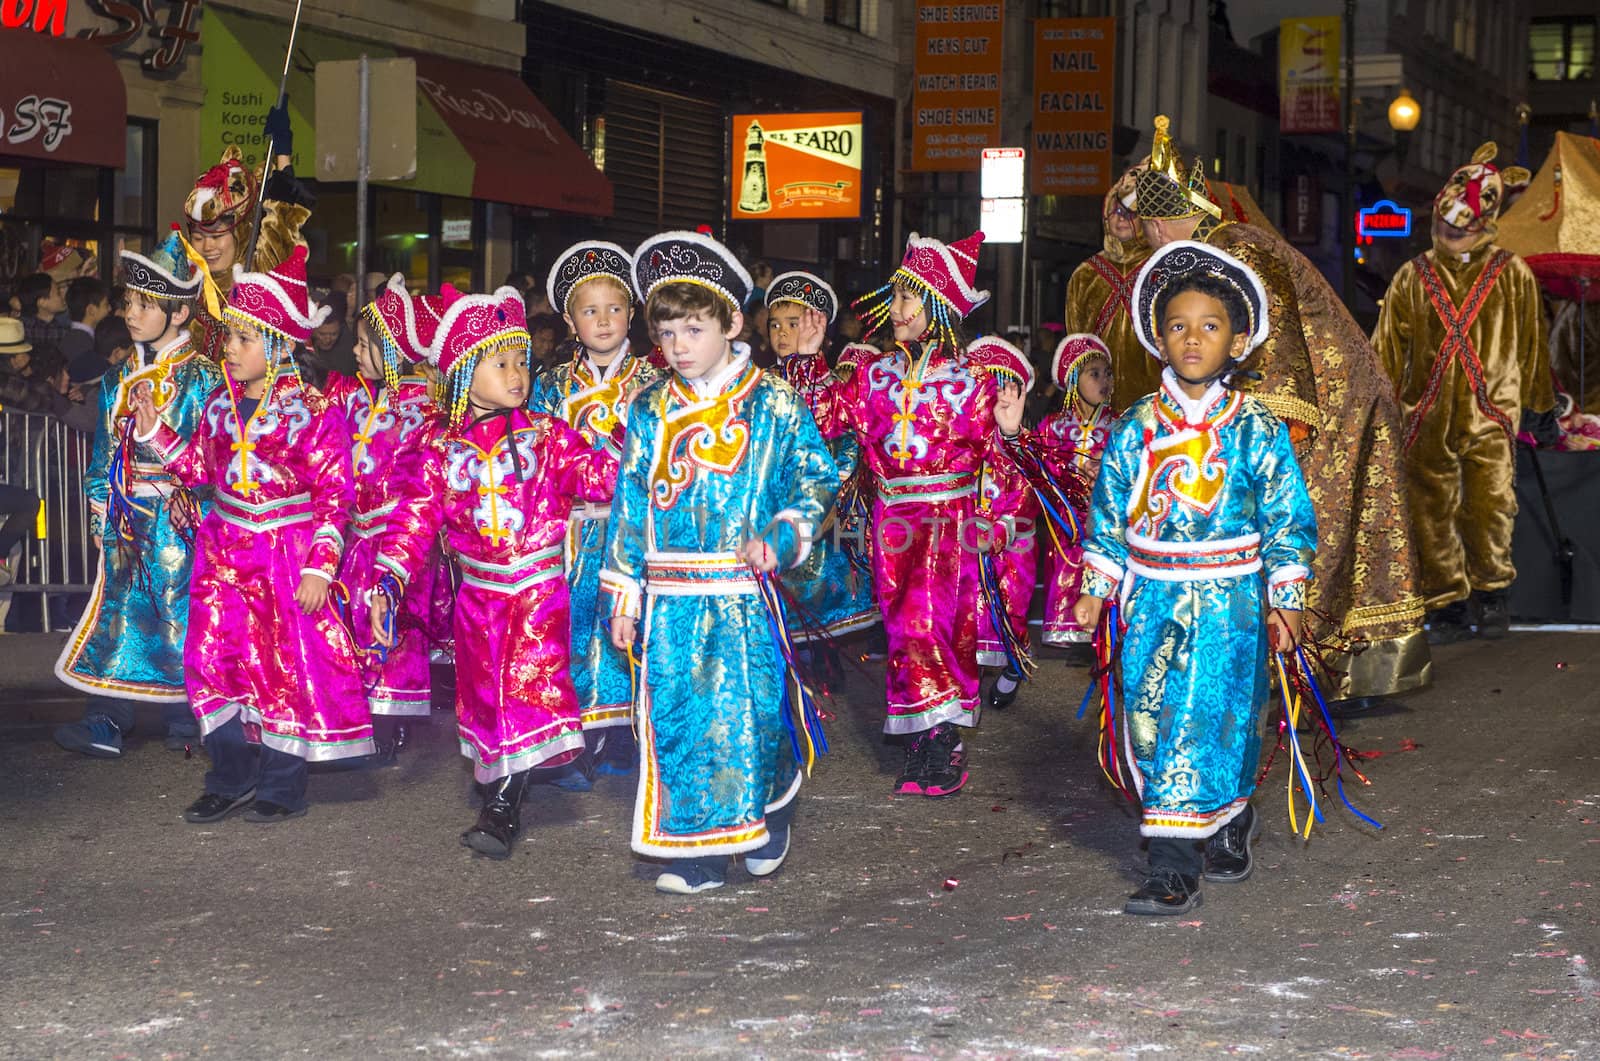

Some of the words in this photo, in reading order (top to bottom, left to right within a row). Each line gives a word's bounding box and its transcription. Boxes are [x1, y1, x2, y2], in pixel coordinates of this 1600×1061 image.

[919, 6, 949, 22] SHOE
[952, 5, 999, 22] SERVICE
[927, 38, 960, 55] KEYS
[963, 37, 990, 55] CUT
[1051, 51, 1099, 72] NAIL
[919, 74, 956, 91] WATCH
[959, 74, 998, 90] REPAIR
[222, 92, 263, 106] Sushi
[1040, 92, 1104, 112] FACIAL
[8, 96, 72, 151] SF
[222, 111, 268, 126] Korea
[919, 108, 953, 126] SHOE
[956, 107, 995, 125] SHINE
[794, 130, 853, 157] FARO
[1036, 132, 1107, 151] WAXING
